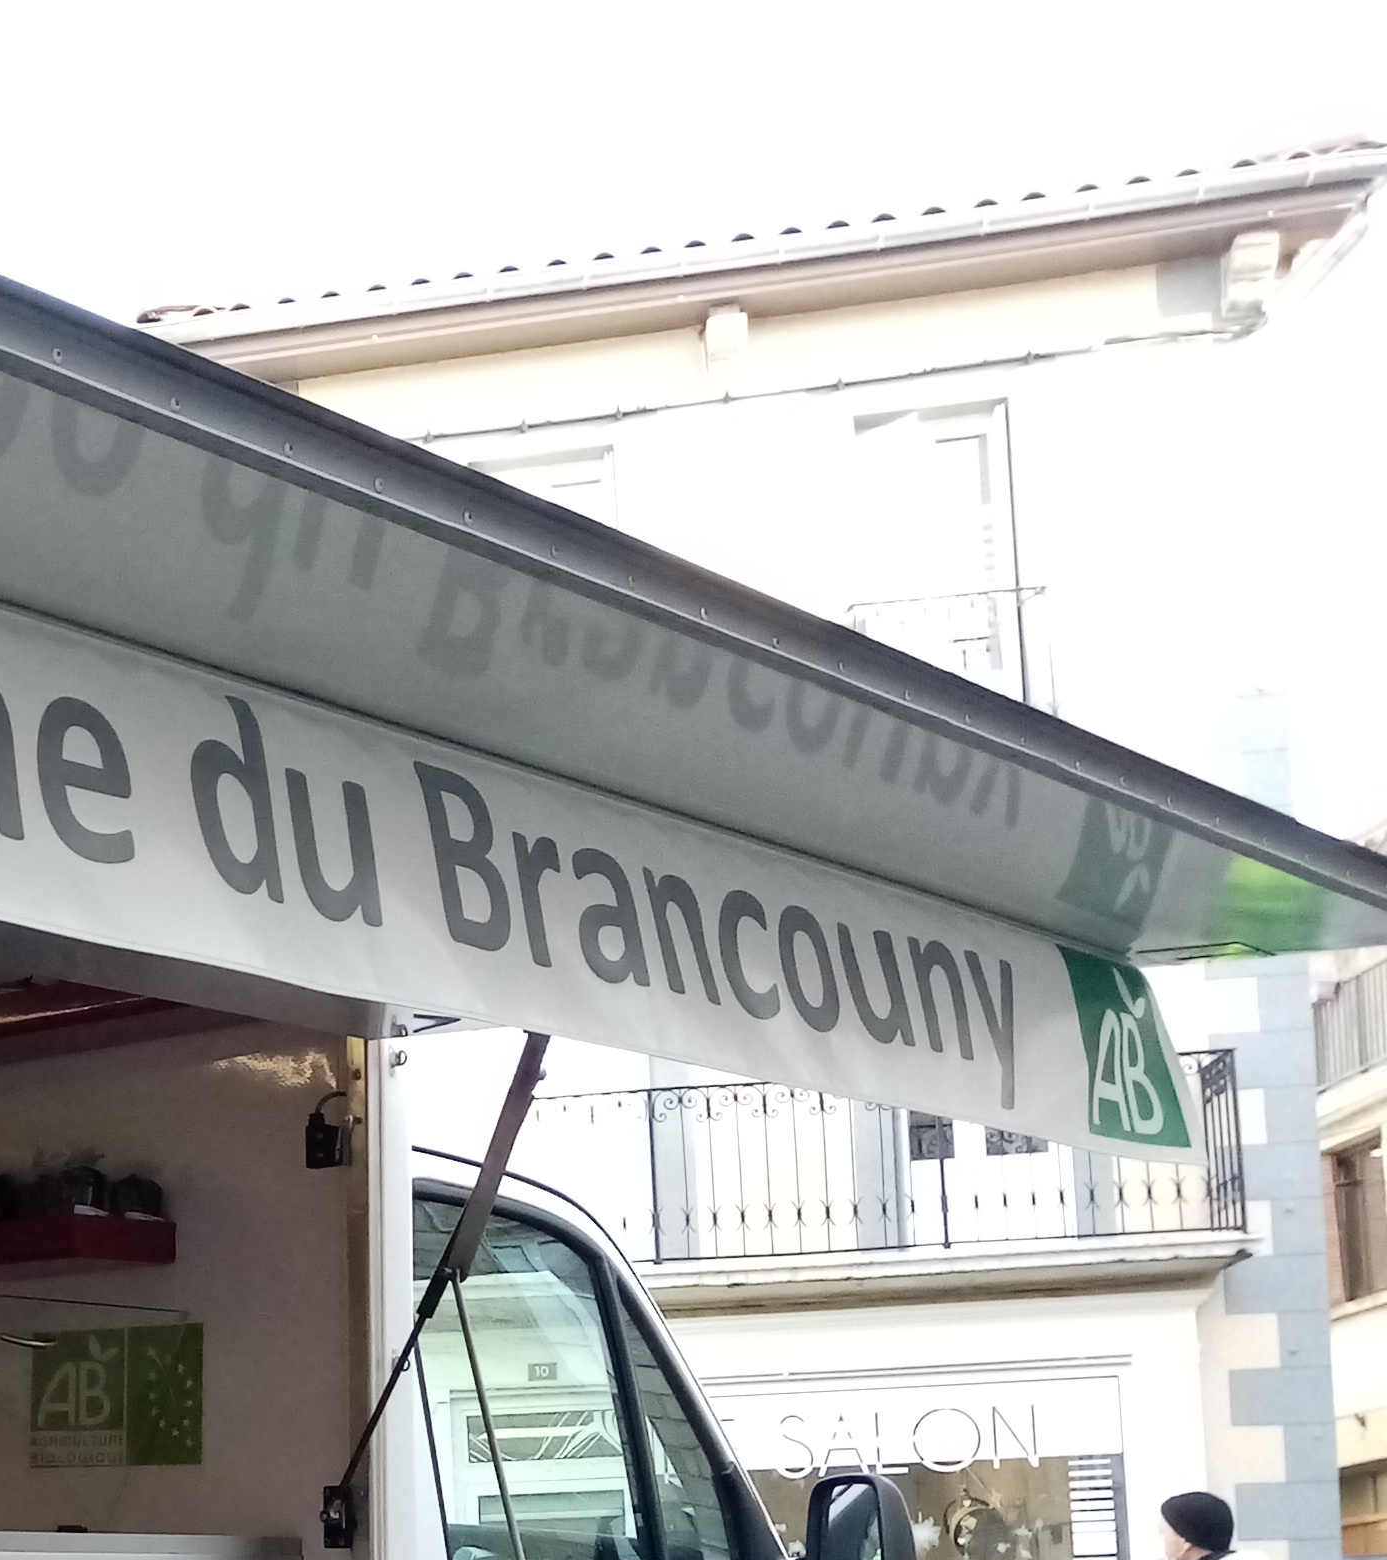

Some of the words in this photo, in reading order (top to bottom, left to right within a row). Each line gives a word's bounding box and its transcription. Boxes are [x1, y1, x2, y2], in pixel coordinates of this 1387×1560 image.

[190, 695, 383, 928] du
[412, 760, 1015, 1110] Brancouny
[1089, 1001, 1165, 1138] AB
[38, 1360, 111, 1427] AB
[777, 1403, 1040, 1479] SALON
